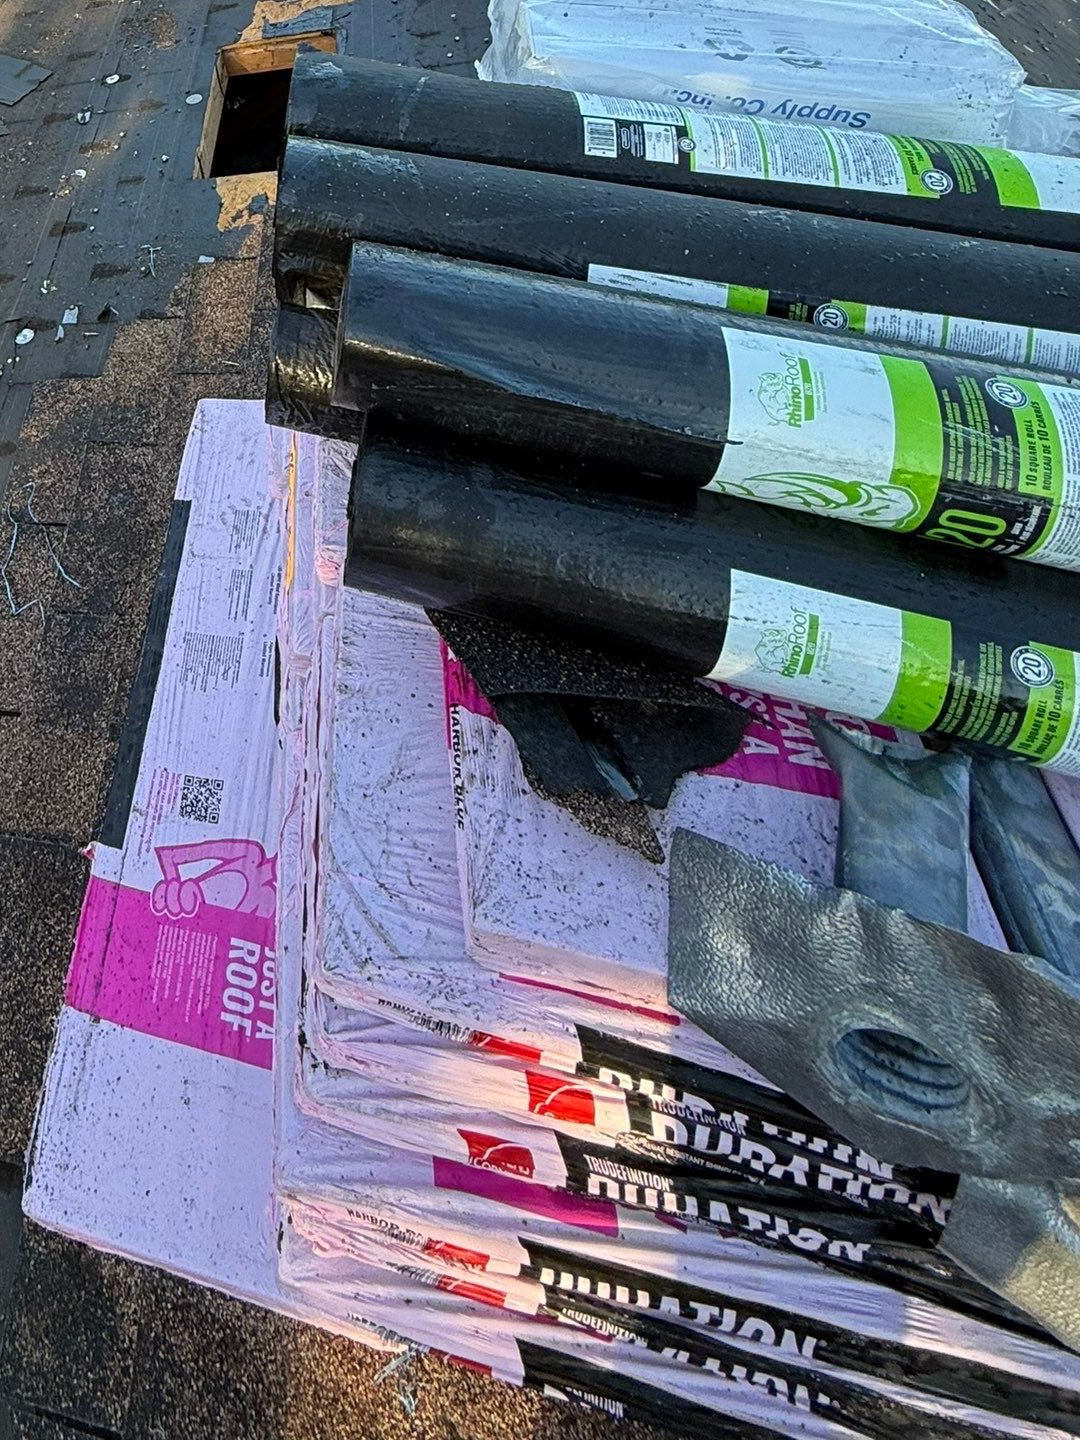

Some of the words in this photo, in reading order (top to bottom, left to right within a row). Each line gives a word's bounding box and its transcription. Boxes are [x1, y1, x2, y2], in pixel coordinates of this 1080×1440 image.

[772, 98, 871, 128] Supply
[928, 174, 944, 188] 20
[821, 310, 839, 327] 20
[779, 351, 802, 428] RhinoRoof
[995, 385, 1016, 401] 20
[1023, 419, 1036, 438] ROLL
[1037, 430, 1050, 442] 10
[1026, 440, 1039, 473] SQUARE
[1042, 444, 1052, 455] DE
[1025, 474, 1038, 486] 10
[1042, 456, 1053, 491] ROULEAU
[781, 605, 807, 678] RhinoRoof
[1022, 657, 1042, 678] 20
[1035, 700, 1048, 719] ROLL
[1047, 710, 1061, 722] 10
[450, 703, 462, 780] HARBOR
[770, 696, 833, 770] HAN
[221, 937, 261, 1038] ROOF
[259, 946, 276, 1010] JUST
[255, 1020, 275, 1039] A
